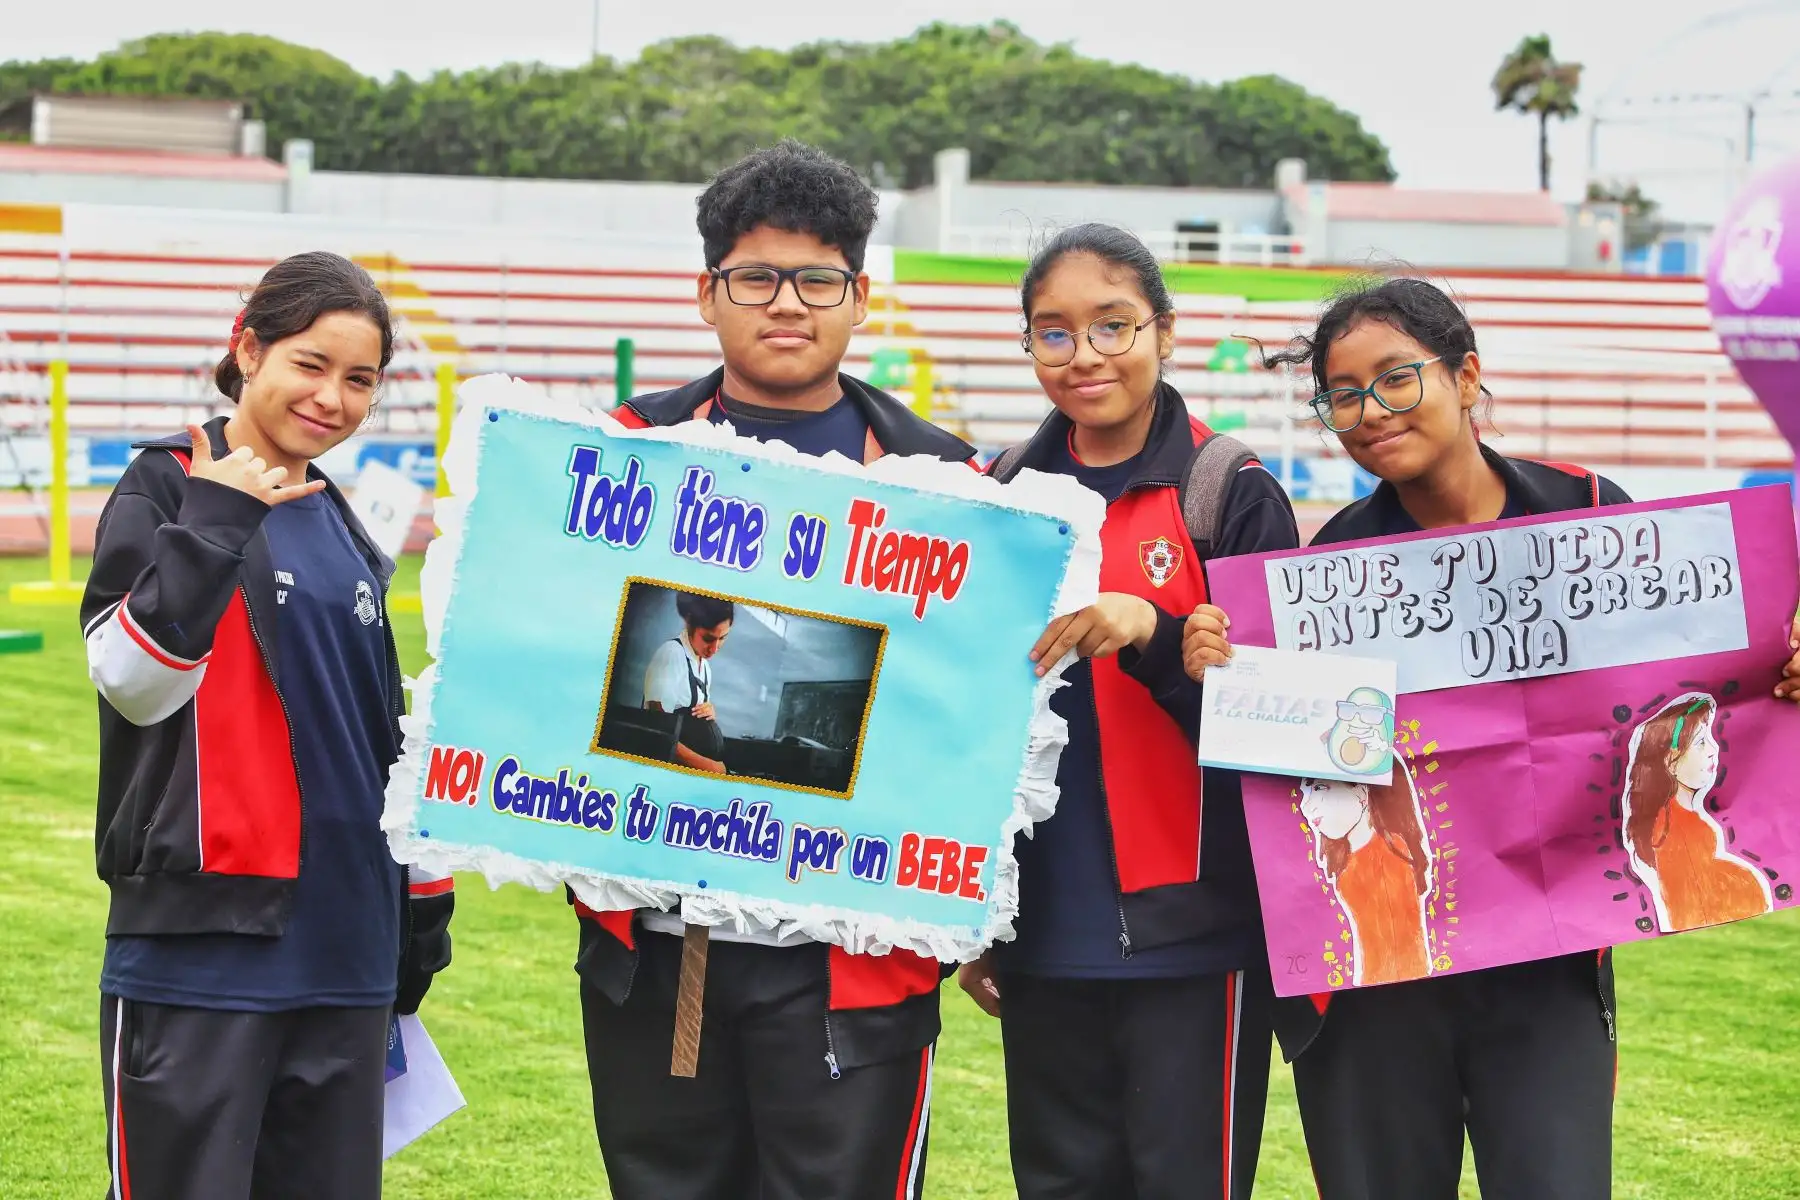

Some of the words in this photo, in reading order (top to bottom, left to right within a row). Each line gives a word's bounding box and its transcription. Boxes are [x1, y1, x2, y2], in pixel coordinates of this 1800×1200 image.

[566, 446, 654, 547] Todo
[673, 468, 765, 570] tiene
[782, 512, 828, 581] su
[843, 498, 970, 621] Tiempo
[1275, 552, 1403, 605] VIVE
[1430, 535, 1497, 592] TU
[1524, 517, 1661, 580] VIDA
[1291, 590, 1455, 652] ANTES
[1476, 575, 1543, 625] DE
[1560, 554, 1733, 620] CREAR
[1460, 618, 1568, 679] UNA
[1214, 708, 1223, 717] A
[1226, 709, 1243, 718] LA
[1247, 711, 1310, 726] CHALACA
[424, 746, 484, 808] NO!
[492, 757, 617, 832] Cambies
[625, 786, 659, 842] tu
[665, 801, 782, 860] mochila
[788, 826, 846, 881] por
[852, 836, 890, 880] un
[896, 833, 988, 903] BEBE.
